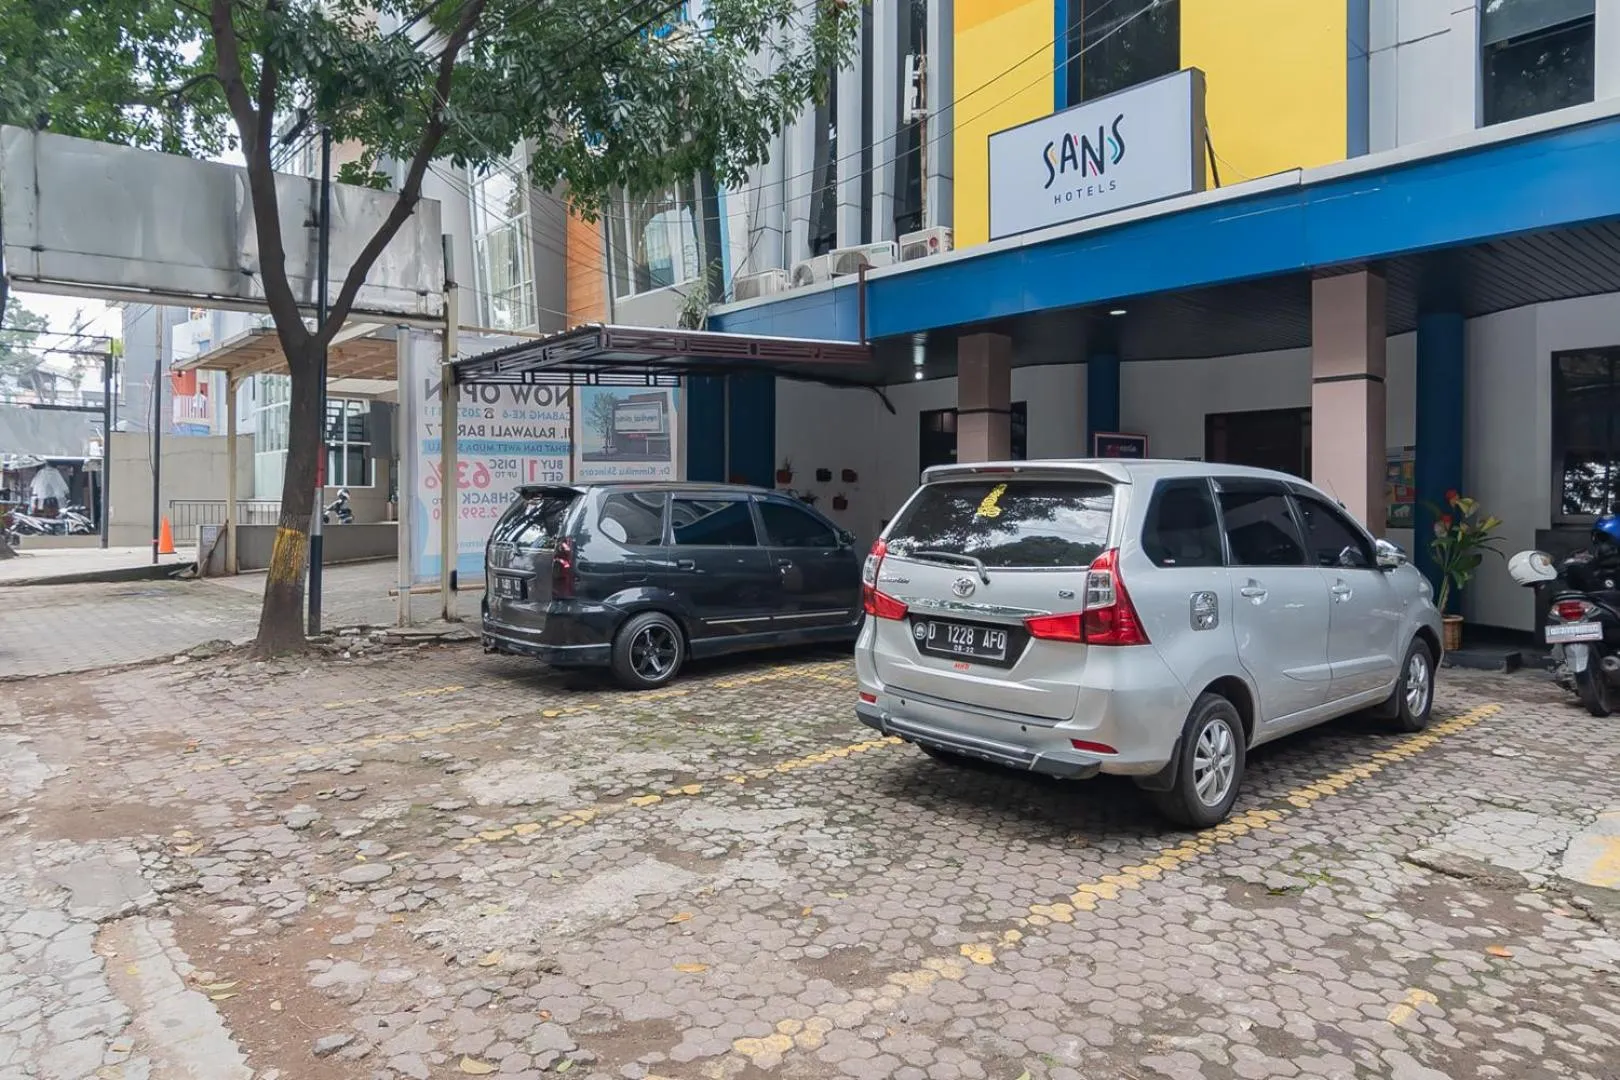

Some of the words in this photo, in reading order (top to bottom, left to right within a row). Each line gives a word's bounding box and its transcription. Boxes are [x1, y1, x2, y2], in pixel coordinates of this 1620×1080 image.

[1043, 113, 1125, 189] SANS
[1054, 180, 1117, 205] HOTELS
[928, 623, 936, 640] D
[947, 625, 974, 645] 1228
